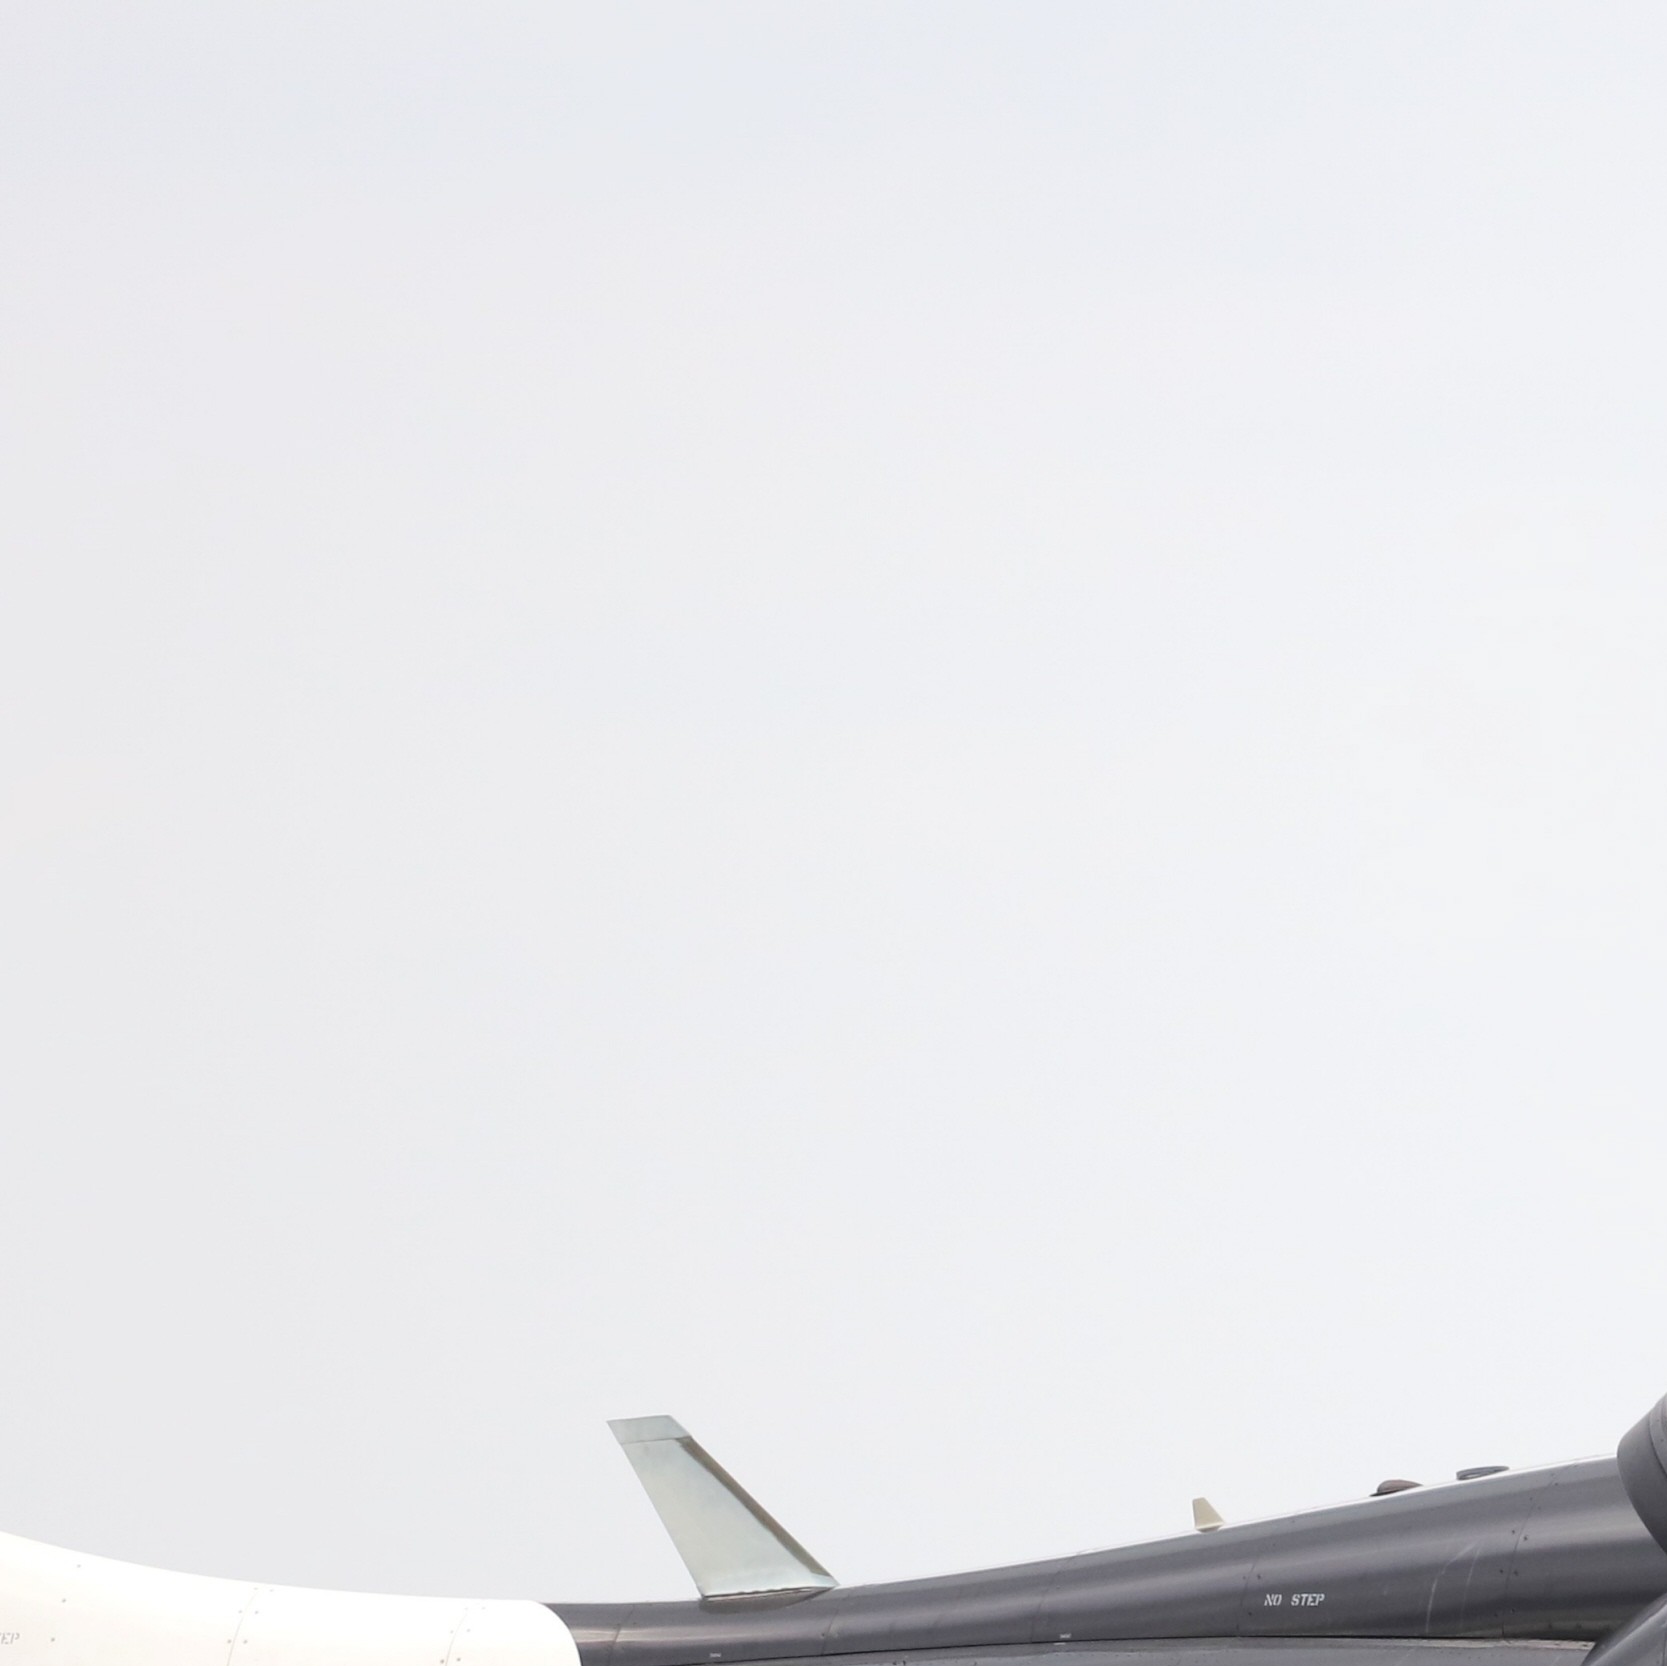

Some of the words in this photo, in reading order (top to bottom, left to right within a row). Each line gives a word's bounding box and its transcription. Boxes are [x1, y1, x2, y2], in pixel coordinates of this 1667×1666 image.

[1264, 1593, 1282, 1606] NO
[1291, 1593, 1325, 1606] STEP
[0, 1632, 20, 1645] EP
